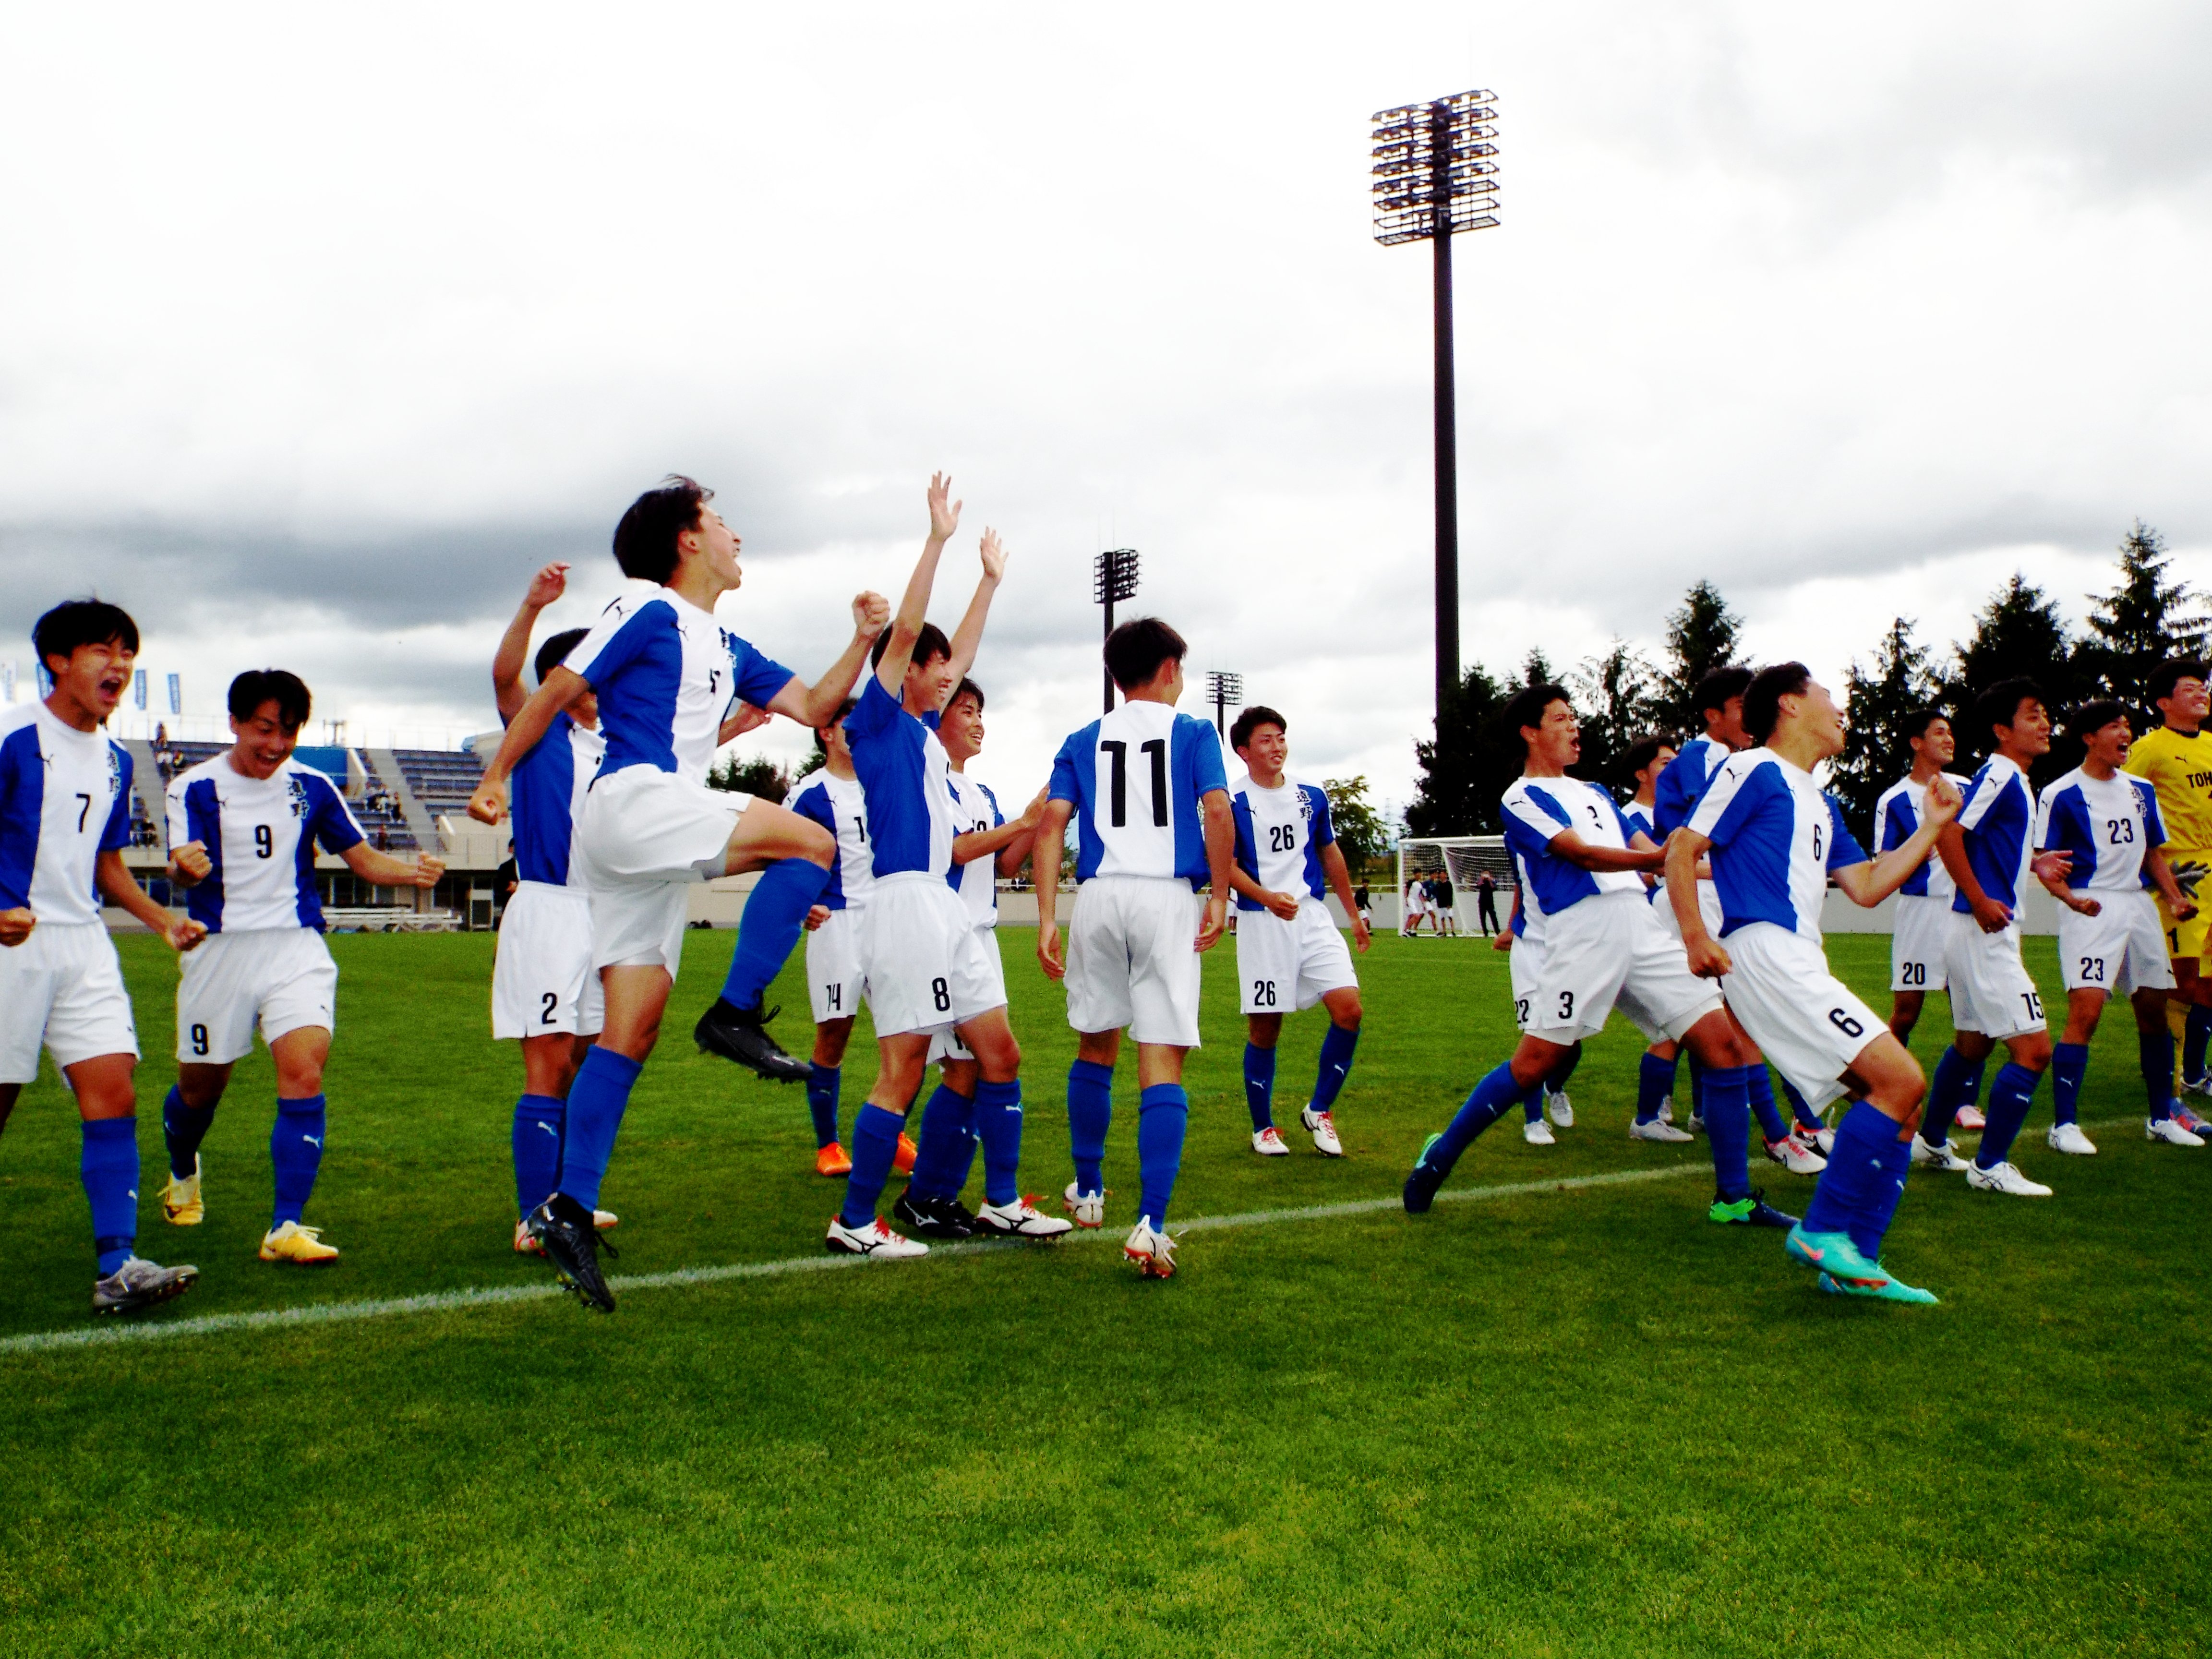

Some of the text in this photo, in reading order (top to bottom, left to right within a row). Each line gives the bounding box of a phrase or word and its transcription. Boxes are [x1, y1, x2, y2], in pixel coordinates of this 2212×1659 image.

[1100, 739, 1168, 828] 11
[76, 793, 90, 833] 7
[255, 825, 272, 859] 9
[1270, 824, 1295, 853] 26
[1814, 824, 1821, 861] 6
[2107, 818, 2134, 844] 23
[2166, 927, 2179, 953] 1
[1902, 962, 1925, 985] 20
[2081, 957, 2104, 982] 23
[826, 983, 841, 1011] 14
[932, 977, 950, 1012] 8
[1254, 980, 1276, 1006] 26
[1558, 991, 1574, 1020] 3
[2020, 993, 2044, 1021] 15
[541, 992, 557, 1025] 2
[1829, 1008, 1863, 1038] 6
[191, 1023, 209, 1056] 9
